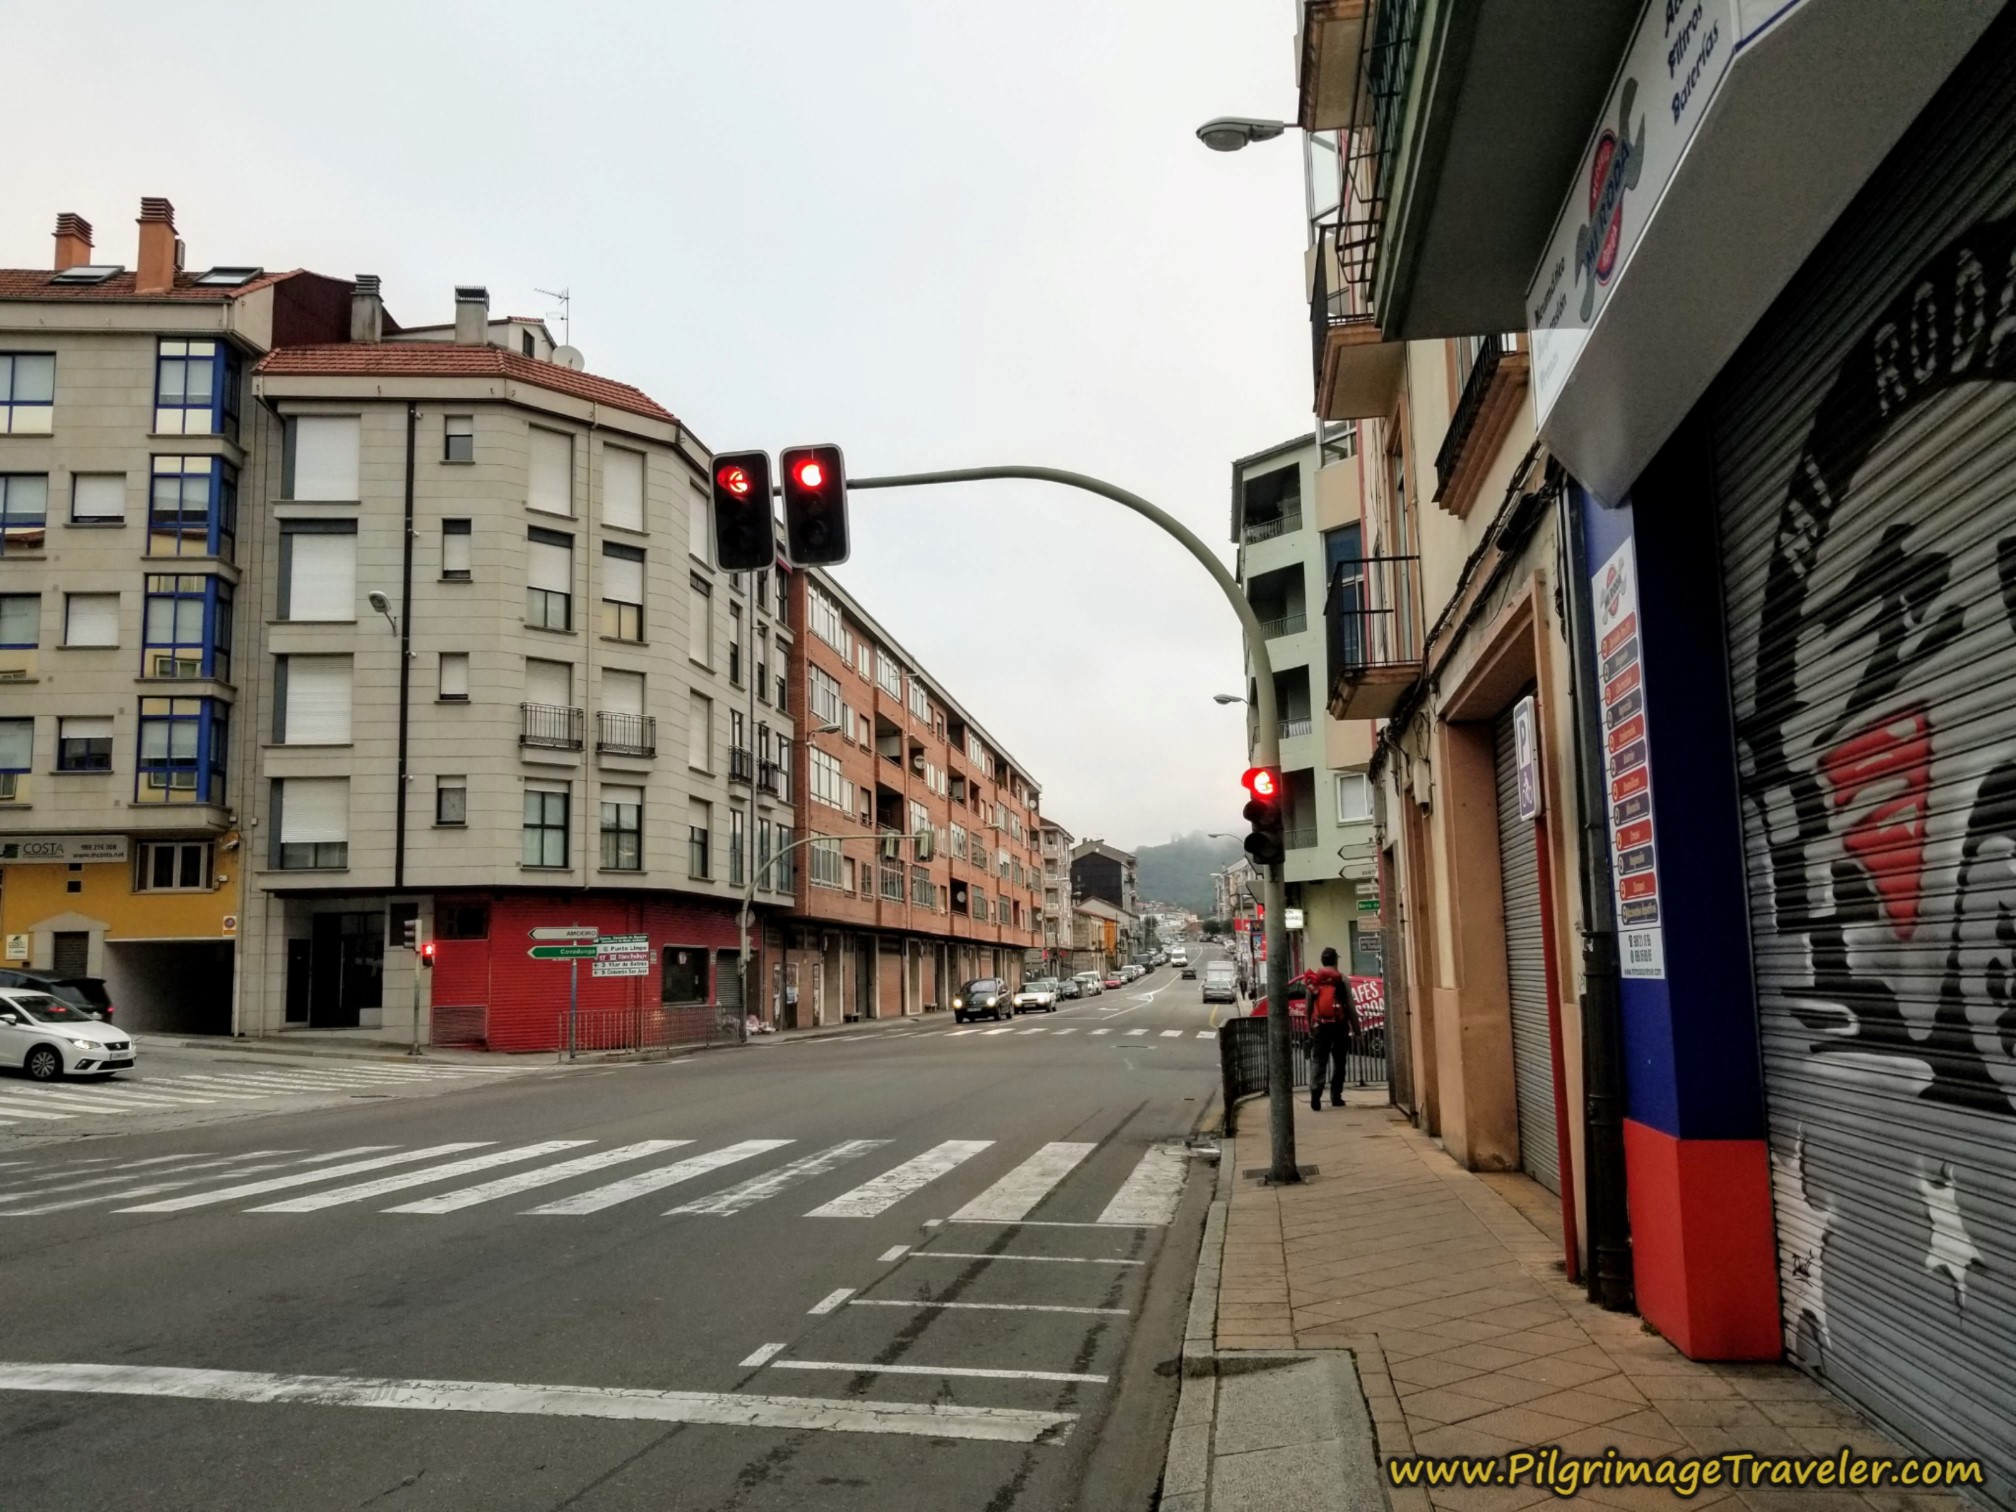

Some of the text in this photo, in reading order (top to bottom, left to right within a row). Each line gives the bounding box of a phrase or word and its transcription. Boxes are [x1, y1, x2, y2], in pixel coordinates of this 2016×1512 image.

[1668, 2, 1702, 80] Filtros
[1672, 19, 1718, 126] Baterías
[1585, 229, 1600, 274] MI
[1599, 138, 1630, 232] RODA
[23, 843, 64, 854] COSTA
[1351, 980, 1379, 1003] AFÉS
